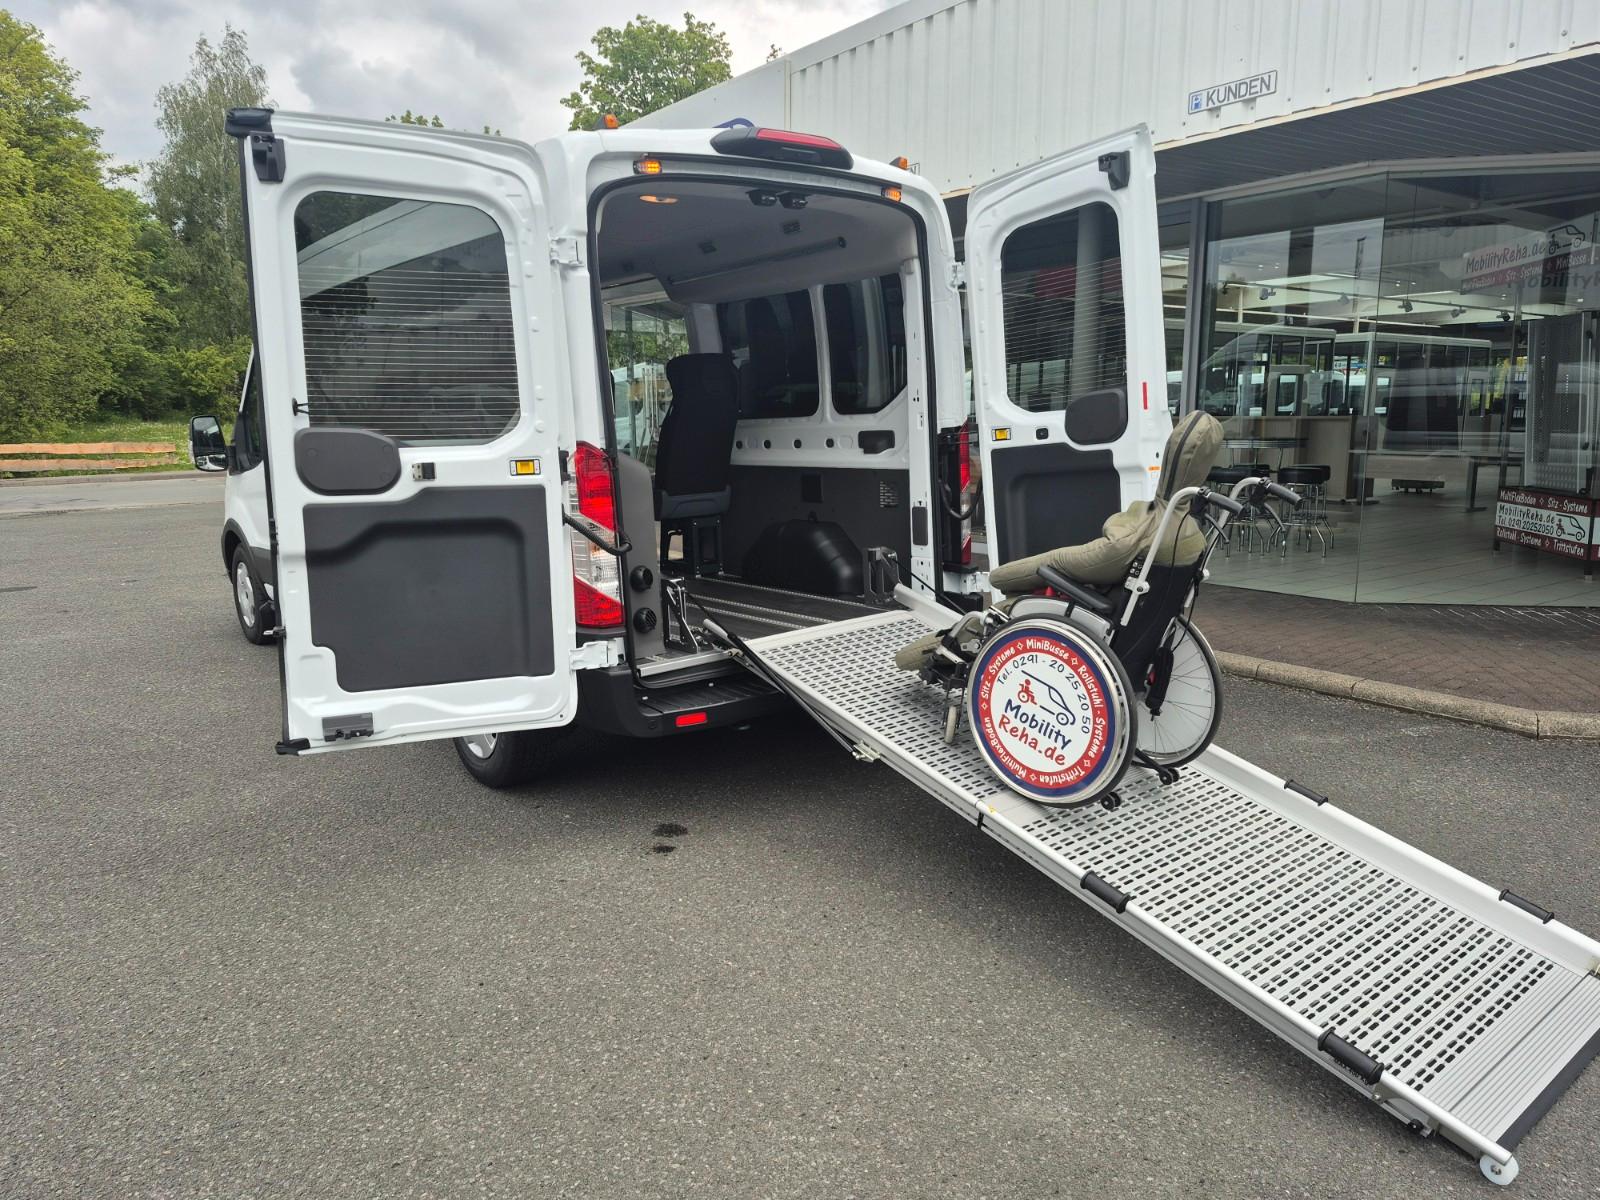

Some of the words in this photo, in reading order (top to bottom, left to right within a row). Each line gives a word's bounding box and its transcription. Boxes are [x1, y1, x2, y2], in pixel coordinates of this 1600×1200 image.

[1206, 75, 1271, 107] KUNDEN
[1498, 503, 1555, 524] MobilityReha.de
[1547, 497, 1559, 509] Sitz
[1563, 499, 1588, 514] Systeme
[1508, 518, 1522, 530] 0291
[1522, 521, 1555, 536] 20252050
[1520, 532, 1542, 546] Systeme
[1553, 539, 1585, 557] Trittstufen
[1025, 638, 1070, 660] MiniBusse
[1012, 654, 1038, 669] 0291
[1049, 659, 1065, 673] 20
[982, 682, 991, 699] Sitz
[988, 646, 1016, 676] Systeme
[1065, 672, 1082, 690] 25
[1077, 665, 1104, 708] Rollstuhl
[1077, 693, 1090, 711] 20
[1004, 698, 1072, 750] Mobility
[1081, 717, 1091, 734] 50
[983, 716, 1028, 779] MultiFlexBoden
[998, 714, 1066, 766] Reha.de
[1087, 716, 1106, 759] Systeme
[1039, 765, 1085, 786] Trittstufen
